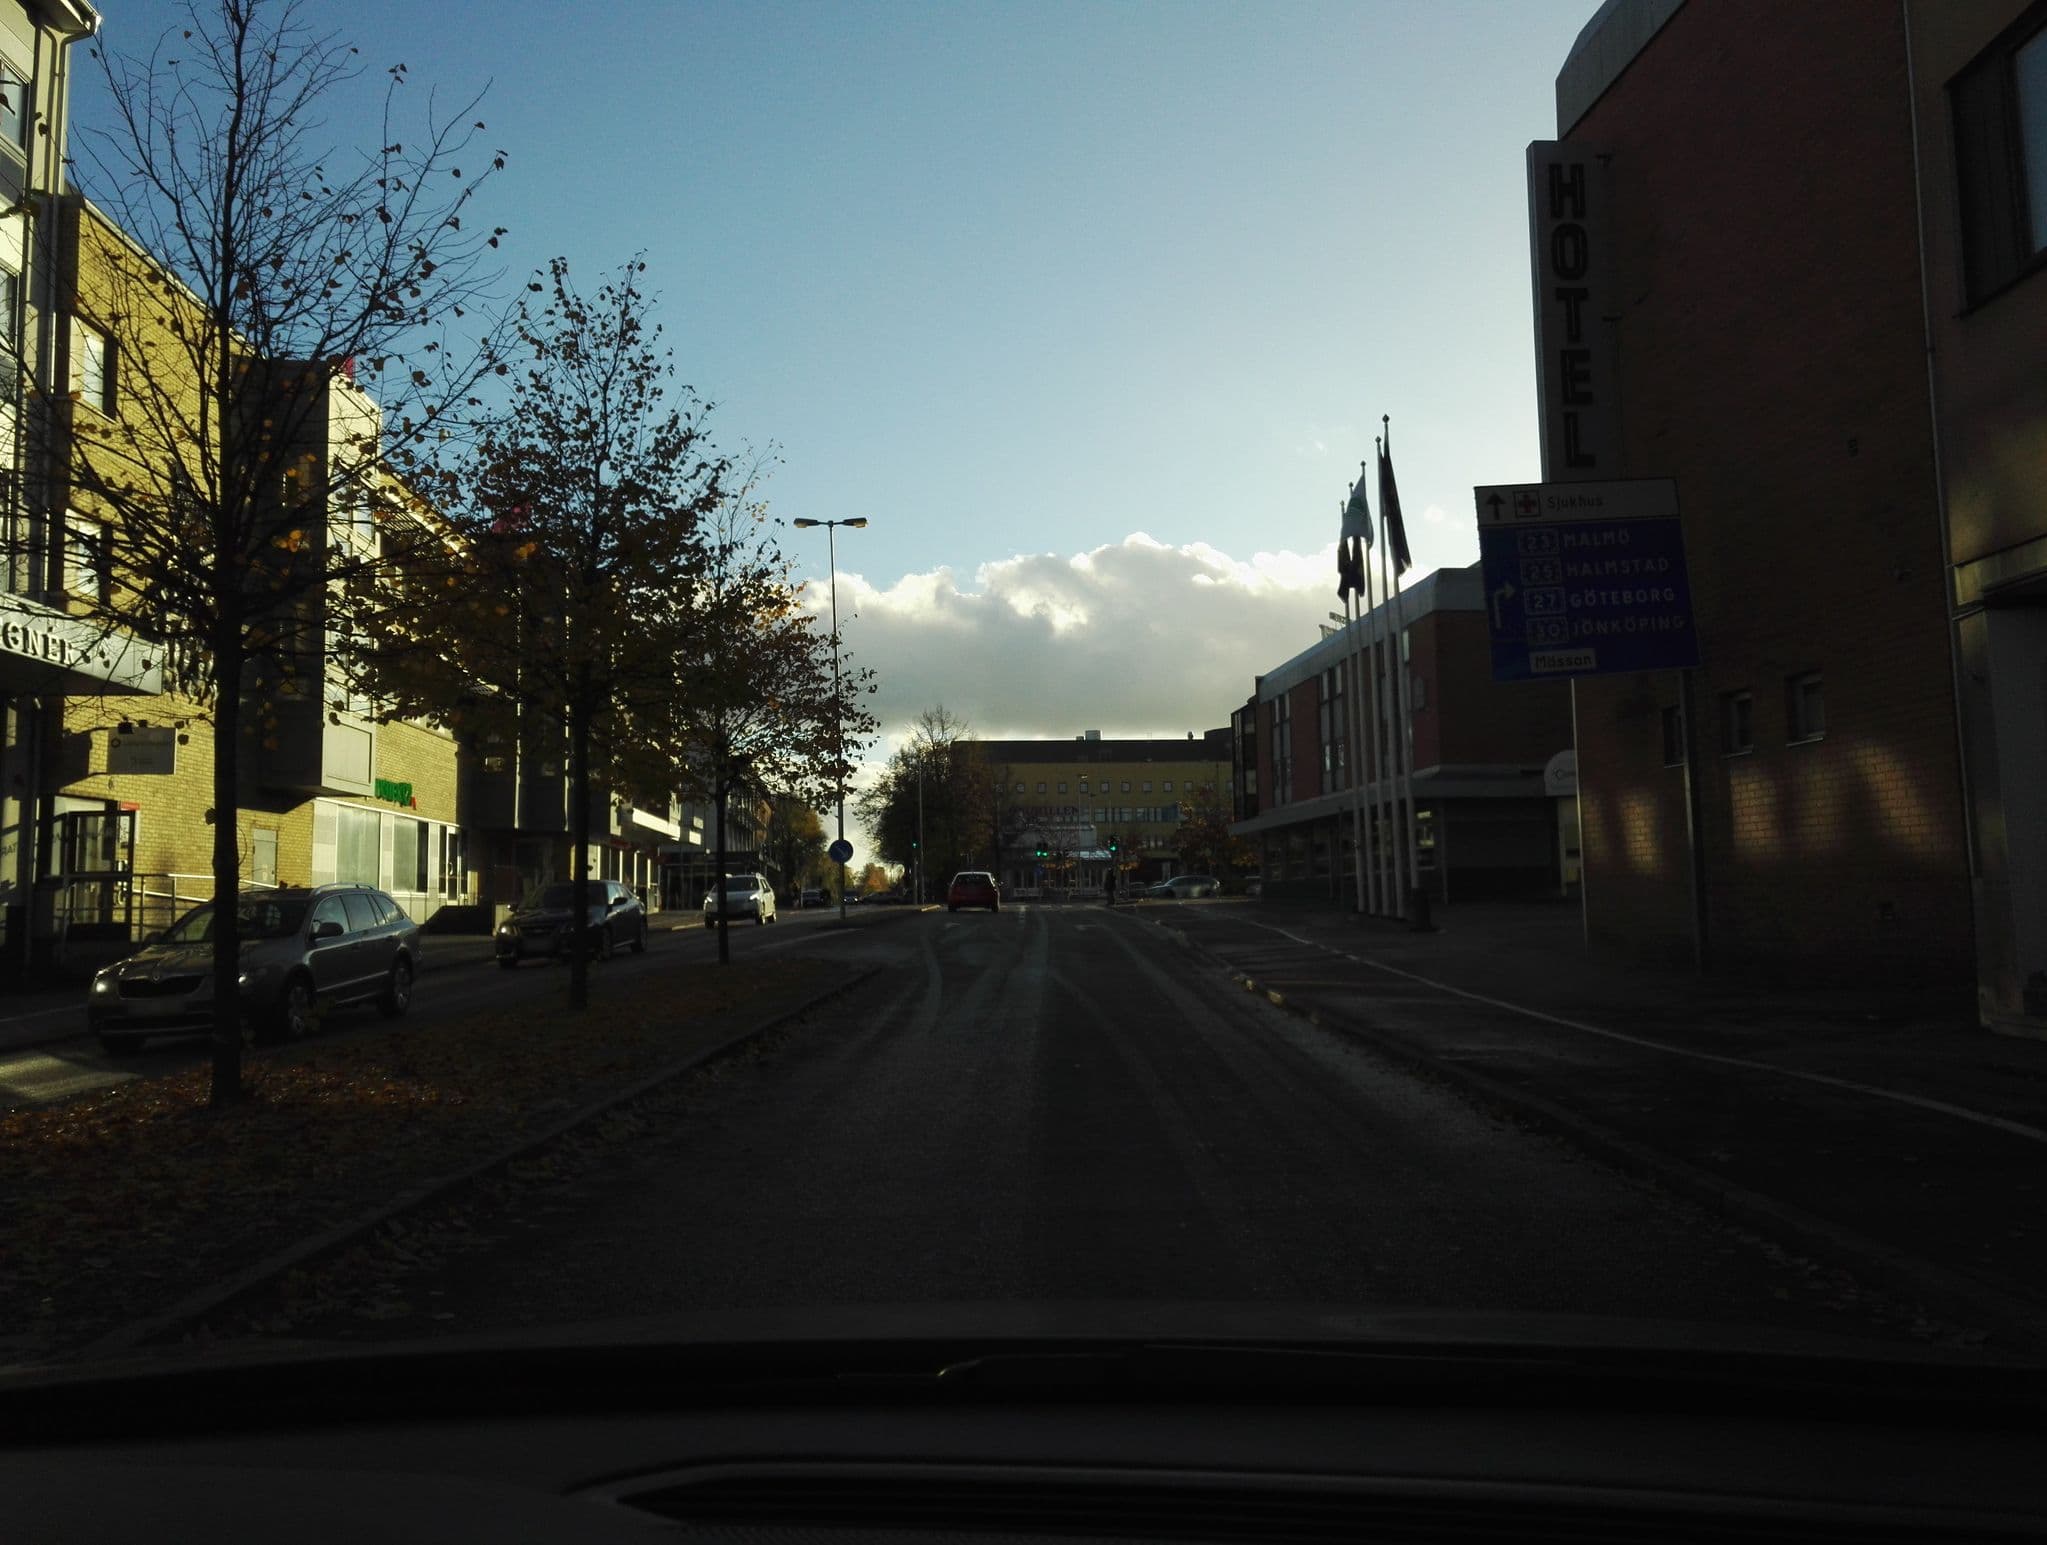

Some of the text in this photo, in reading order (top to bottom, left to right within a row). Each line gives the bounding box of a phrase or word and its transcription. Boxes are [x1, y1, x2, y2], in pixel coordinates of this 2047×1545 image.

[1549, 163, 1595, 468] HOTEL
[1546, 495, 1603, 512] Sjukhus
[1563, 527, 1632, 548] MALMÖ
[1566, 557, 1669, 577] HALMSTAD
[1534, 587, 1675, 609] 27 GÖTEBORG
[1572, 615, 1685, 637] JÖNKÖPING
